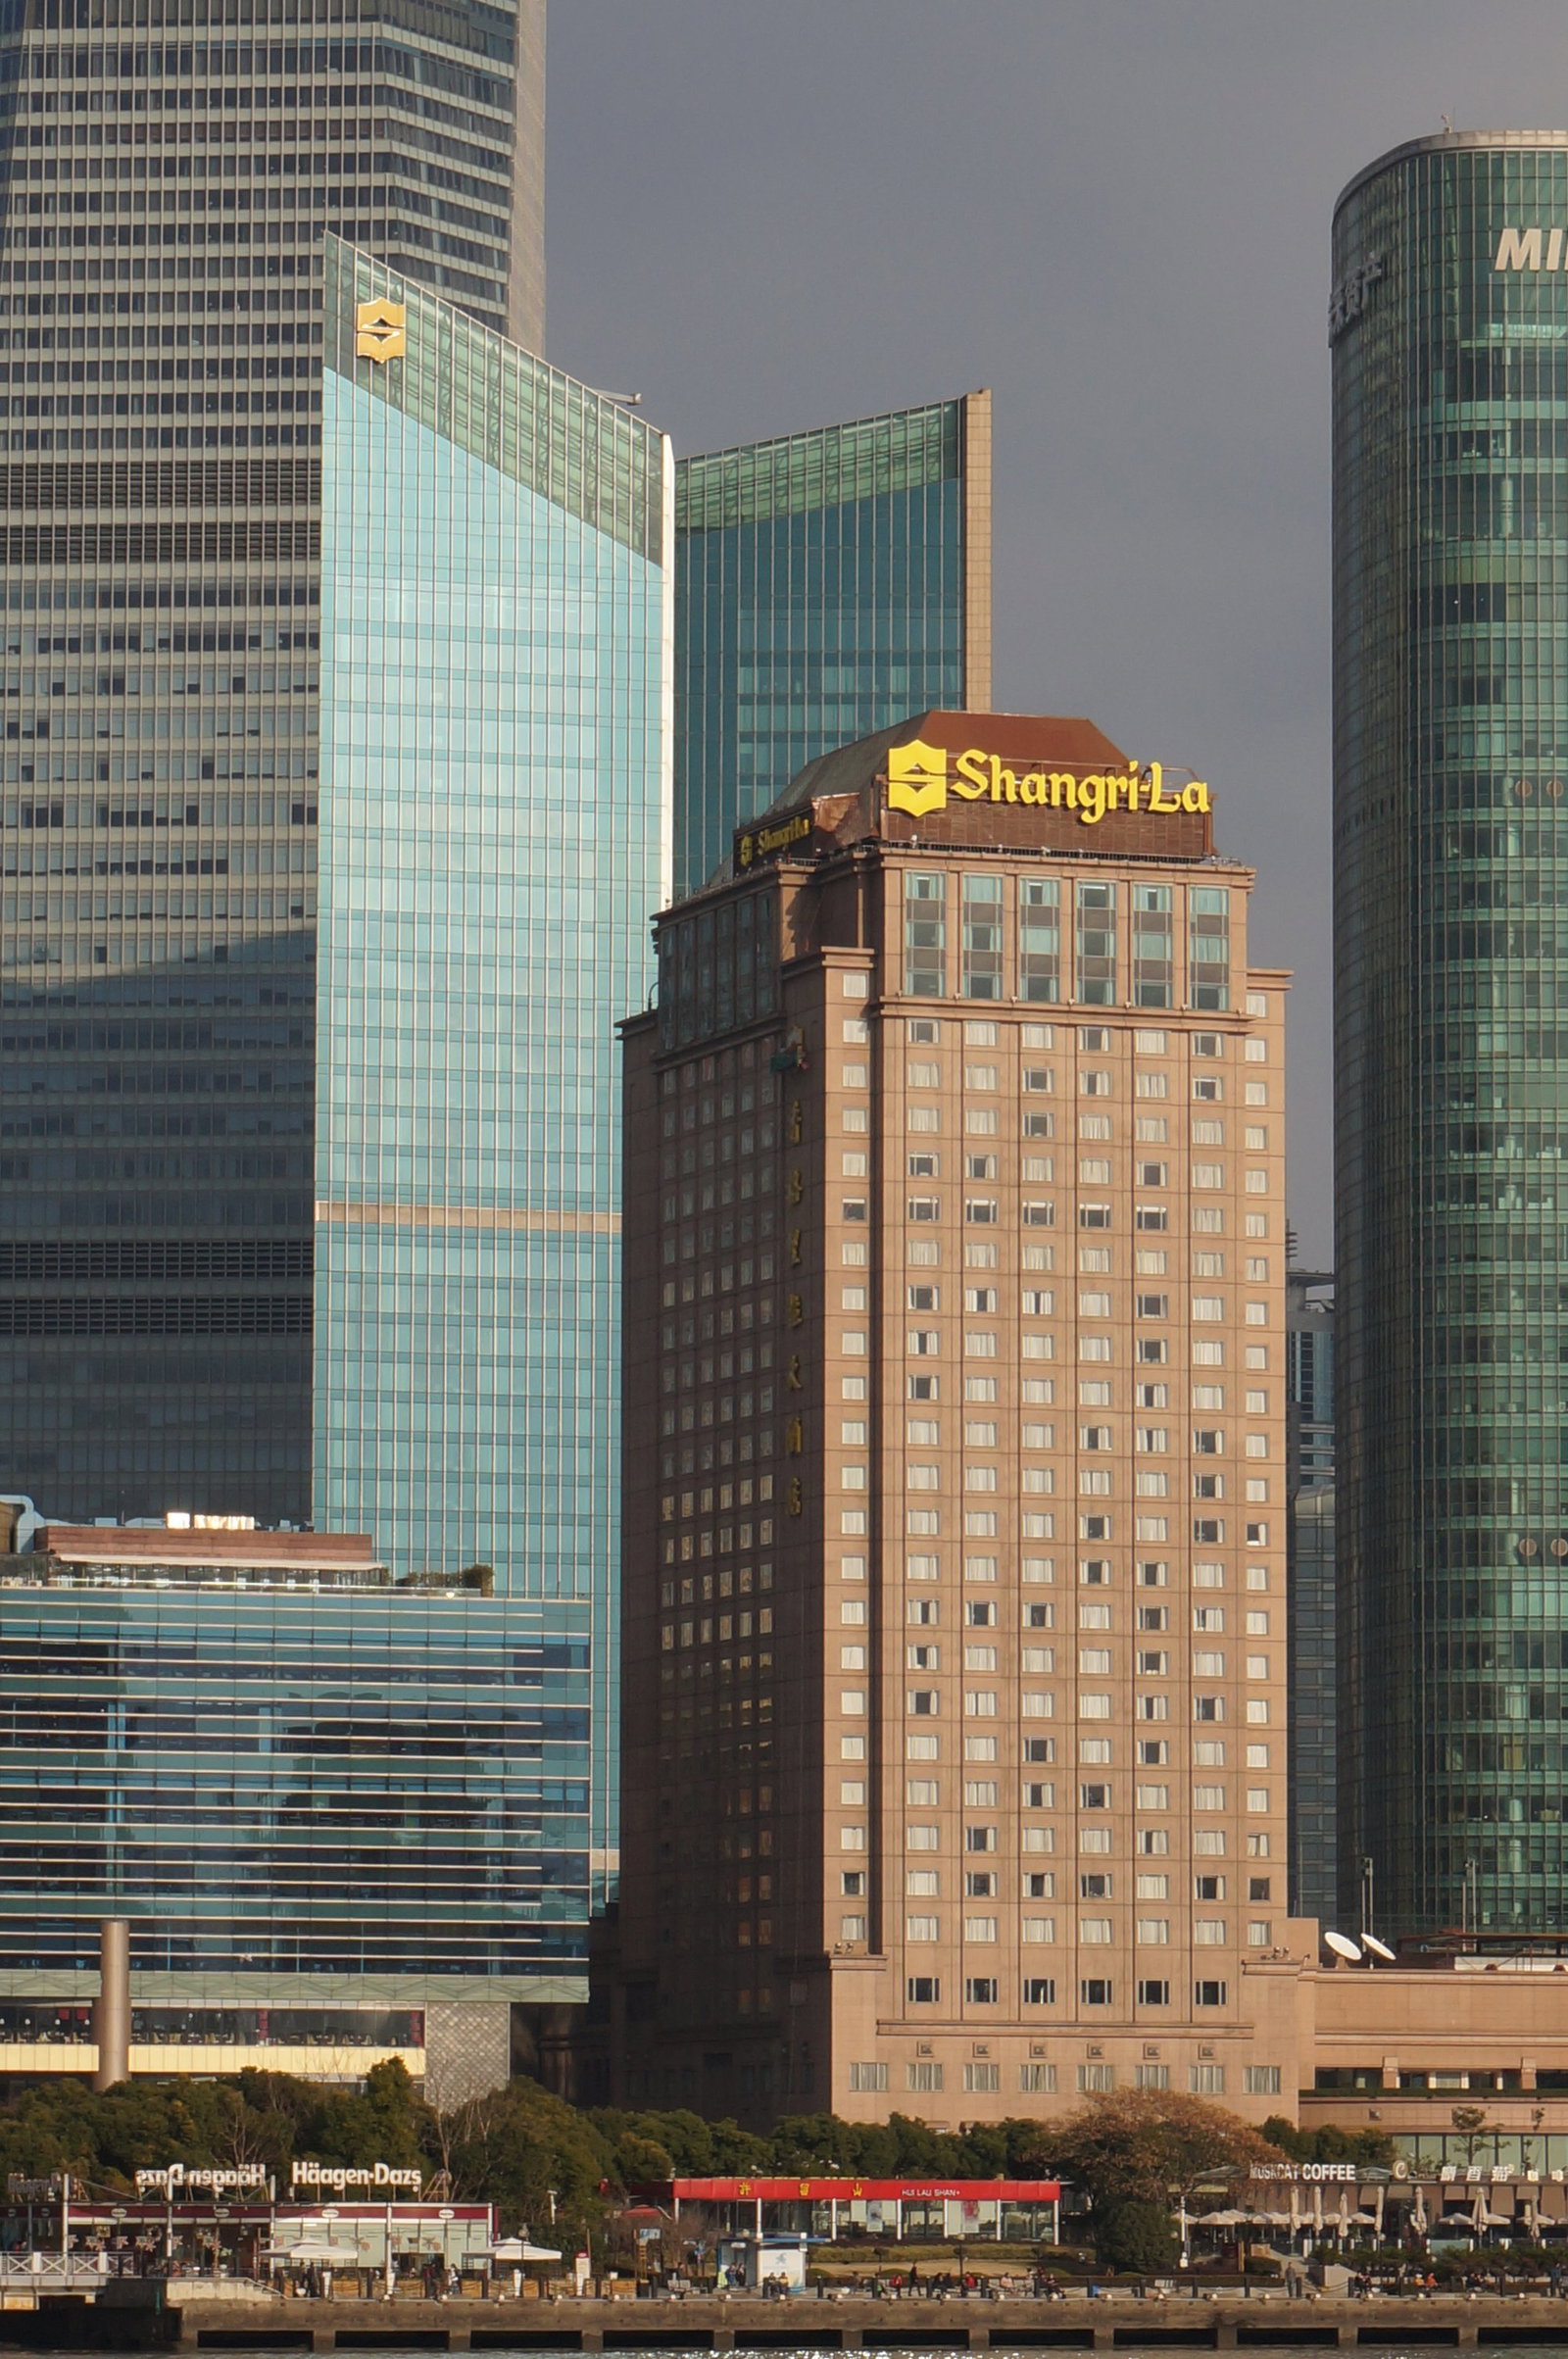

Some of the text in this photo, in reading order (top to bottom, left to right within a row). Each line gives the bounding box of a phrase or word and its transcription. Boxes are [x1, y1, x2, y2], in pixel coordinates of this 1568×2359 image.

[1494, 228, 1568, 270] MI
[951, 749, 1209, 824] Shangri-La
[292, 2161, 422, 2192] Häagen-Dazs
[1301, 2163, 1356, 2181] COFFEE
